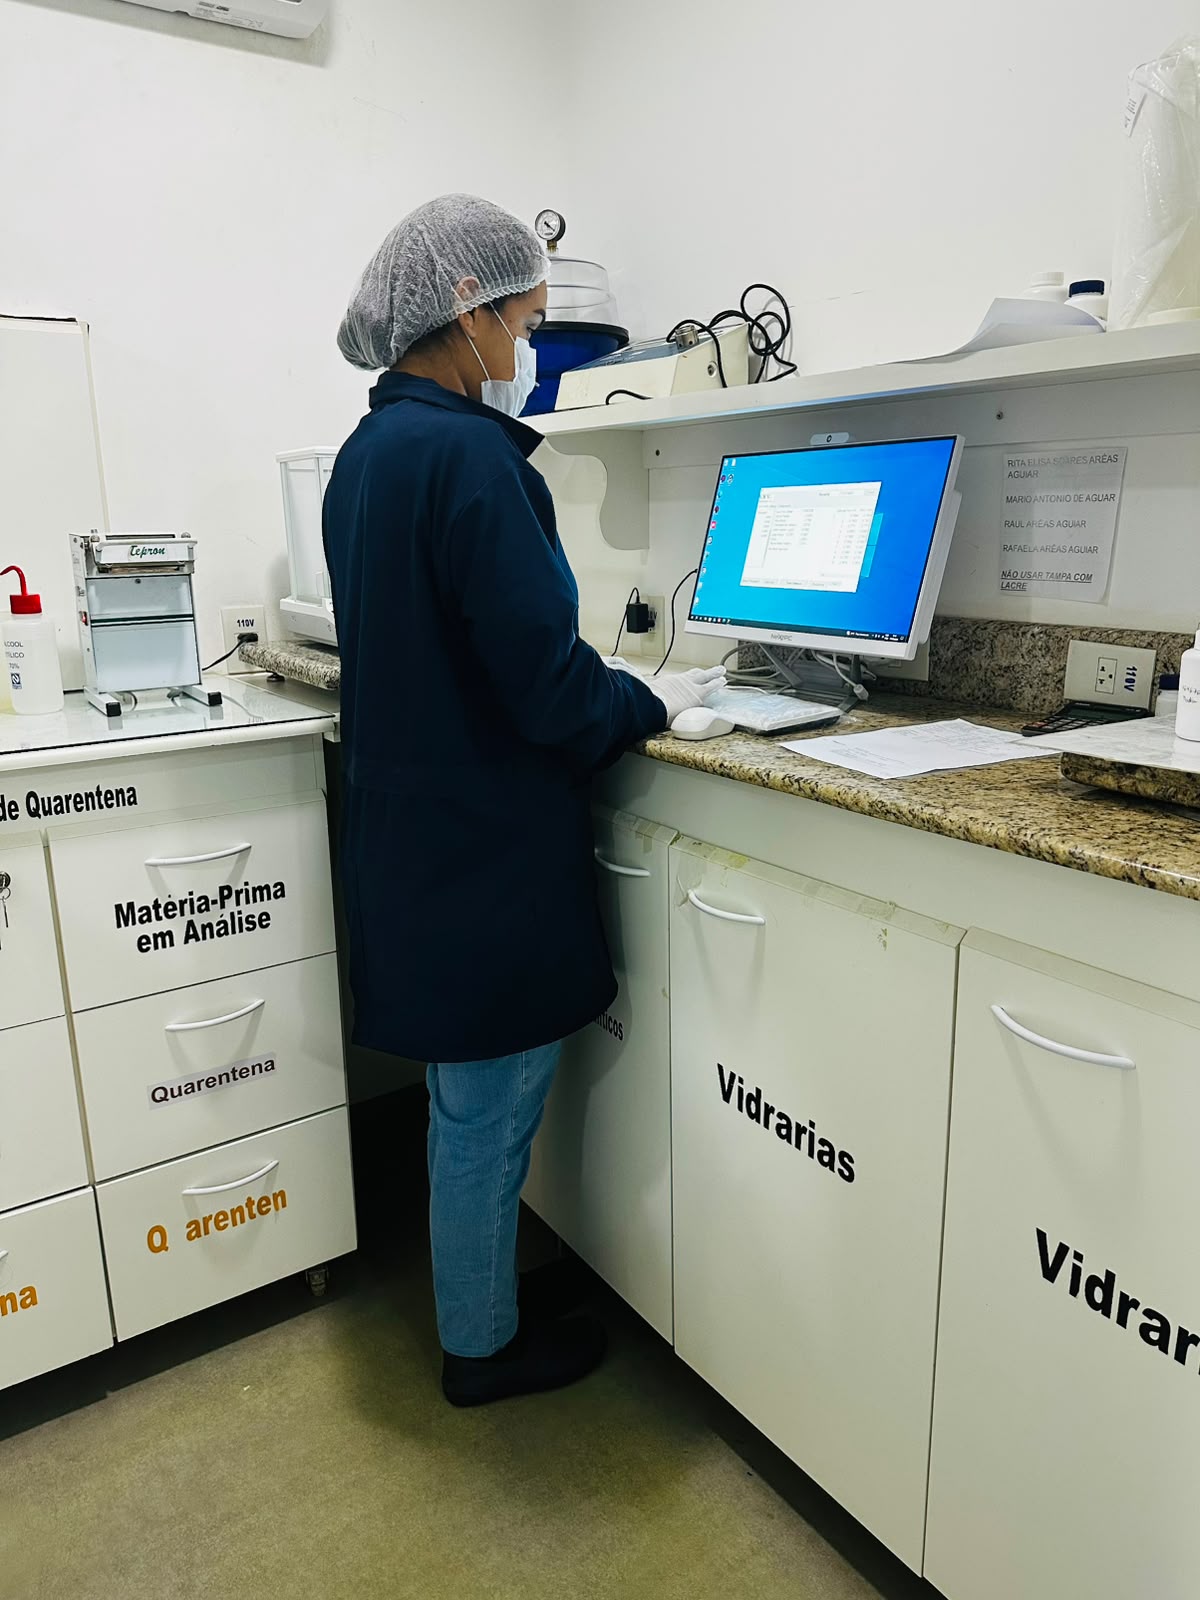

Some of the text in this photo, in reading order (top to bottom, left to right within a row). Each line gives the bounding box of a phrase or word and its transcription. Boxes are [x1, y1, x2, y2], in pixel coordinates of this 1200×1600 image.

[1007, 453, 1119, 468] RITA ELISA SOARES ARÉAS
[1007, 469, 1039, 479] AGUIAR
[1006, 495, 1032, 504] MARIO
[1032, 494, 1072, 504] ANTONIO
[1073, 494, 1084, 503] DE
[1004, 518, 1087, 528] RAUL ARÉAS AGUIAR
[130, 545, 165, 558] Tepron
[1002, 543, 1099, 555] RAFAELA ARÉAS AGUIAR
[1001, 569, 1093, 581] NÃO USAR TAMPA COM
[1000, 581, 1027, 590] LACRE
[236, 618, 255, 628] 110V
[1123, 666, 1138, 692] 110V
[25, 784, 138, 820] Quarentena
[114, 880, 286, 929] Matéria-Prima
[136, 910, 271, 953] em Análise
[150, 1057, 276, 1104] Quarentena
[717, 1062, 856, 1183] Vidrarias
[1035, 1226, 1200, 1376] Vidrar
